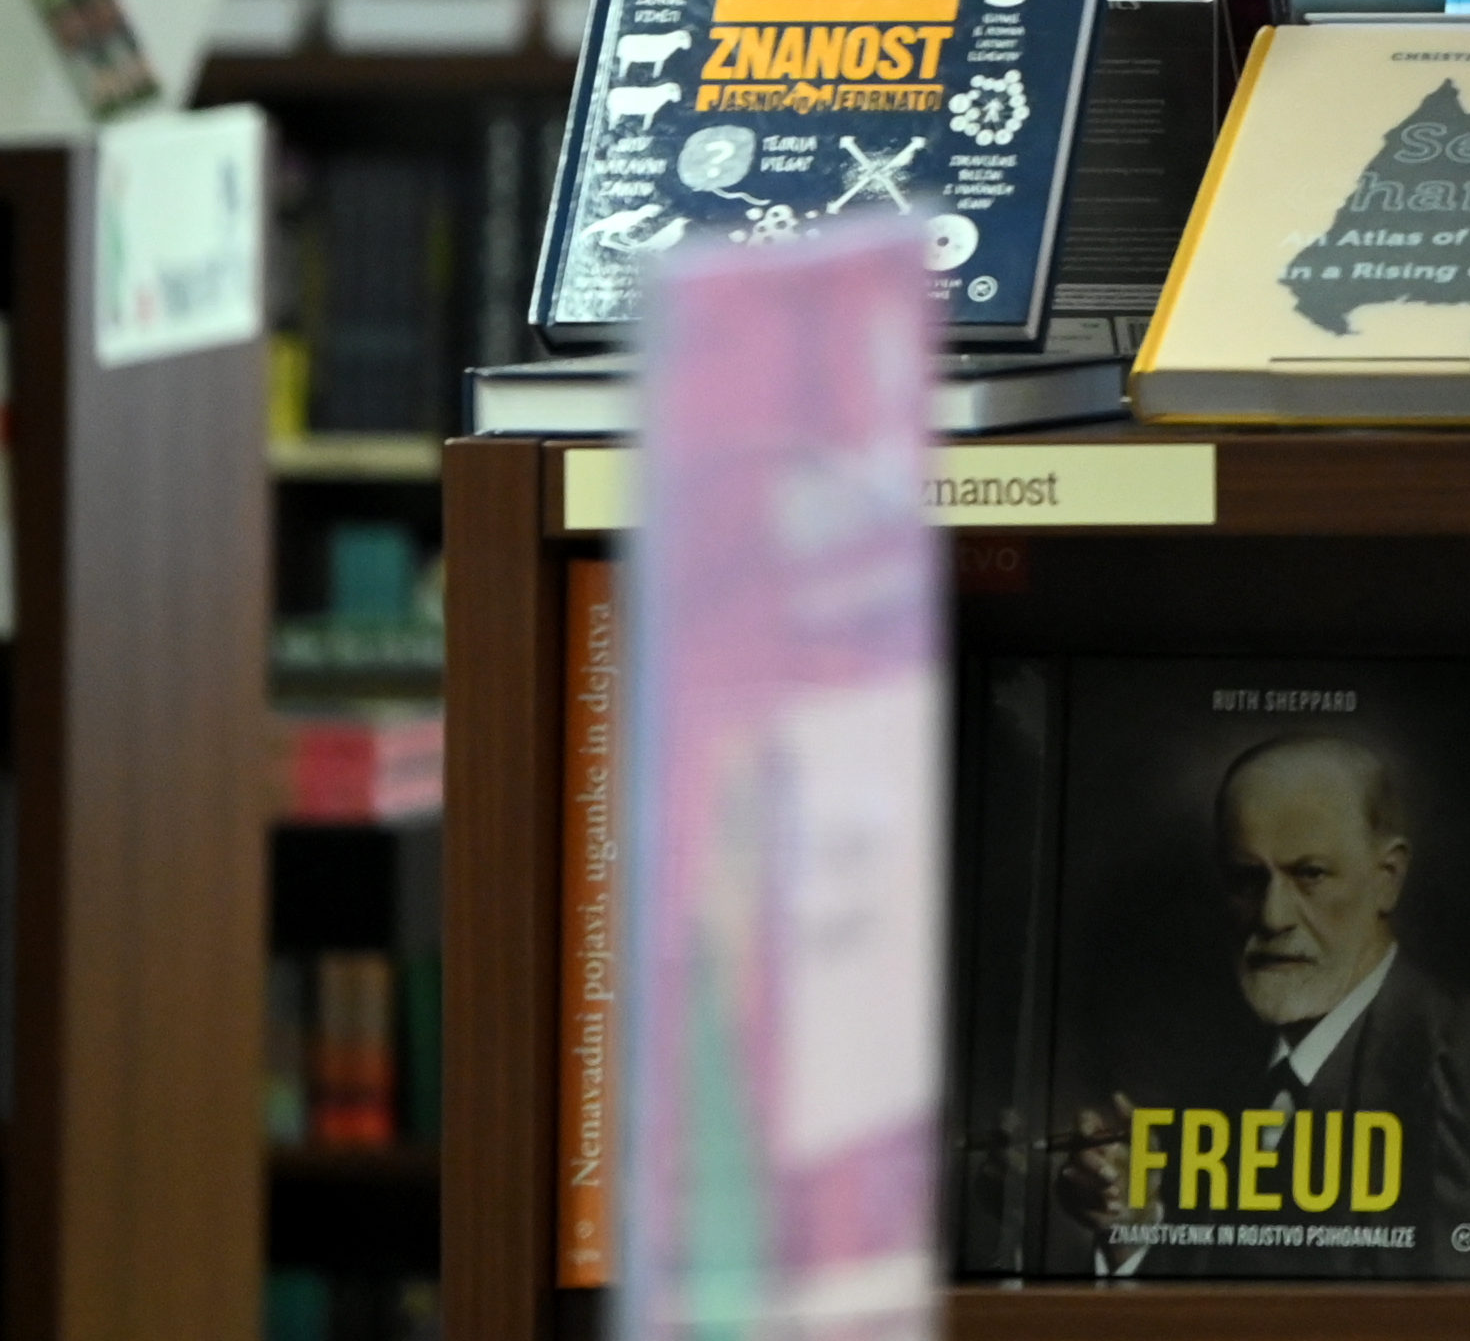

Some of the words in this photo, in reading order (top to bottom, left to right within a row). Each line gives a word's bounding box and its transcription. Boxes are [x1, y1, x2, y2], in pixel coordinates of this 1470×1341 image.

[701, 26, 954, 80] ZNANOST
[1337, 229, 1428, 247] Atlas
[1432, 228, 1469, 247] of
[1321, 267, 1343, 281] a
[1351, 262, 1459, 284] Rising
[577, 603, 620, 714] dejstva
[1212, 690, 1260, 712] RUTH
[1264, 690, 1357, 713] SHEPPARD
[580, 722, 608, 757] in
[575, 765, 618, 883] uganke
[576, 893, 615, 1002] pojavi,
[571, 1012, 603, 1188] Nenavadni
[1128, 1107, 1403, 1212] FREUD
[1217, 1224, 1235, 1245] IN
[1237, 1225, 1304, 1247] ROJSTVO
